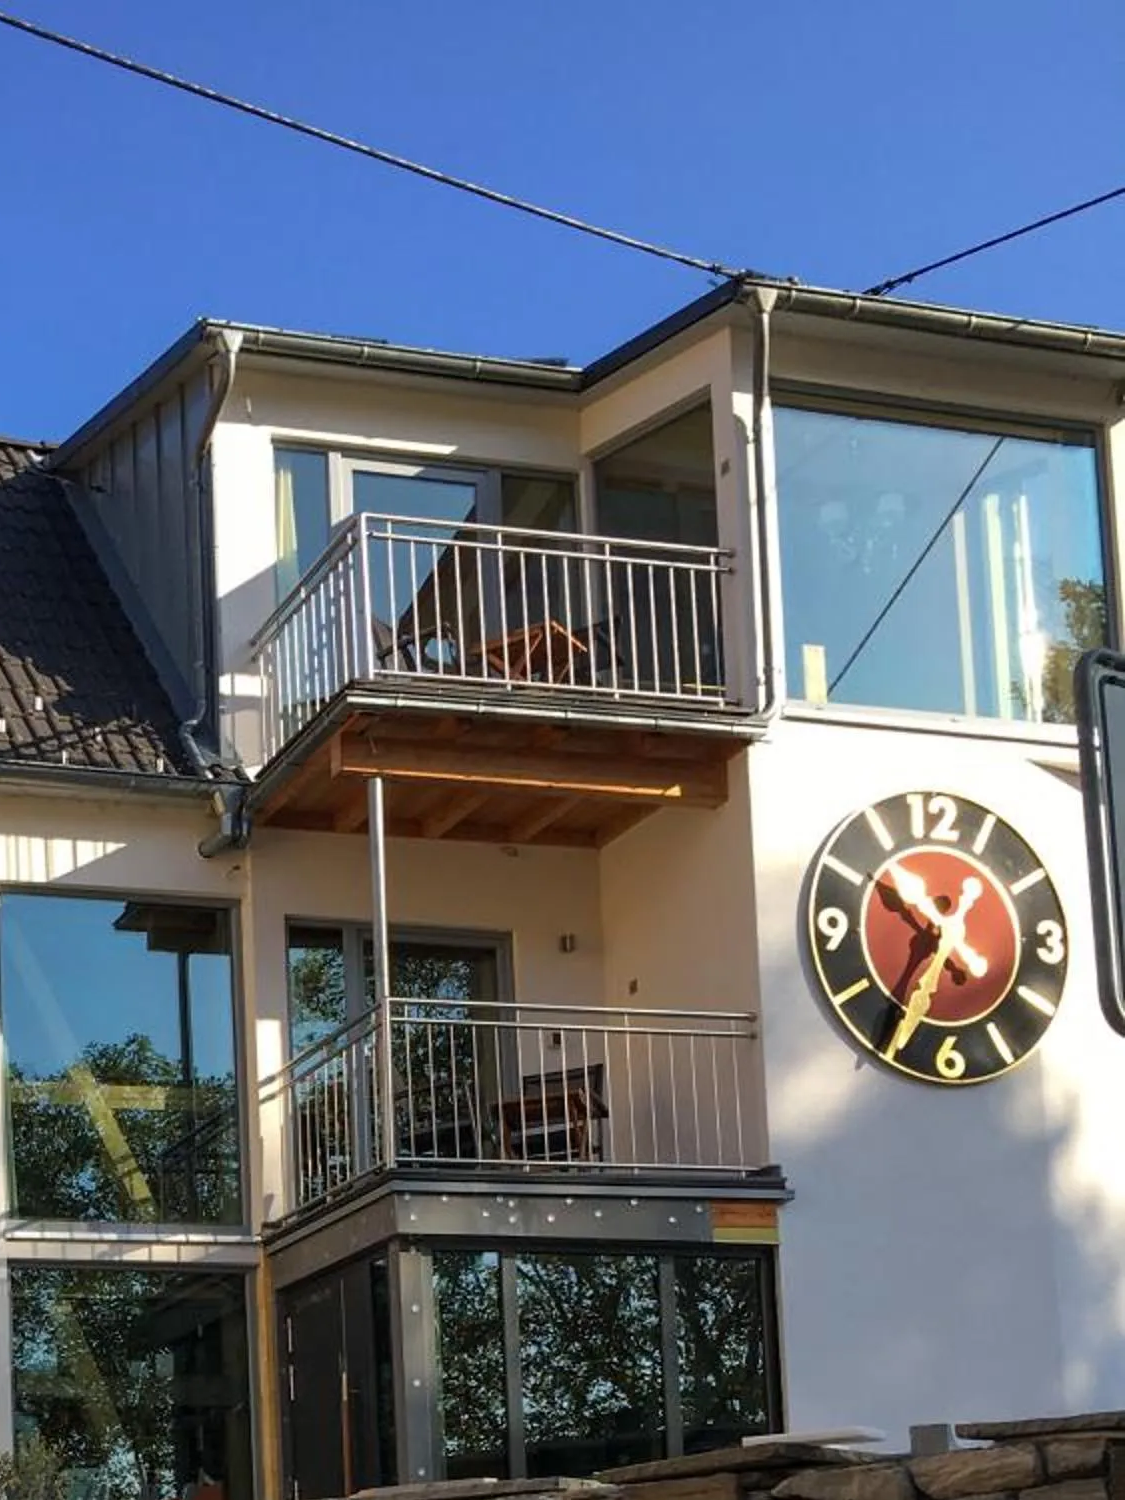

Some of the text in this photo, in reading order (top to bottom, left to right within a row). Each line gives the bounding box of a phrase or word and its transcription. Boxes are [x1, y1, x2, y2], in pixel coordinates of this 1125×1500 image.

[907, 793, 960, 843] 12
[817, 907, 849, 951] 9
[1036, 919, 1064, 965] 3
[936, 1036, 966, 1079] 6
